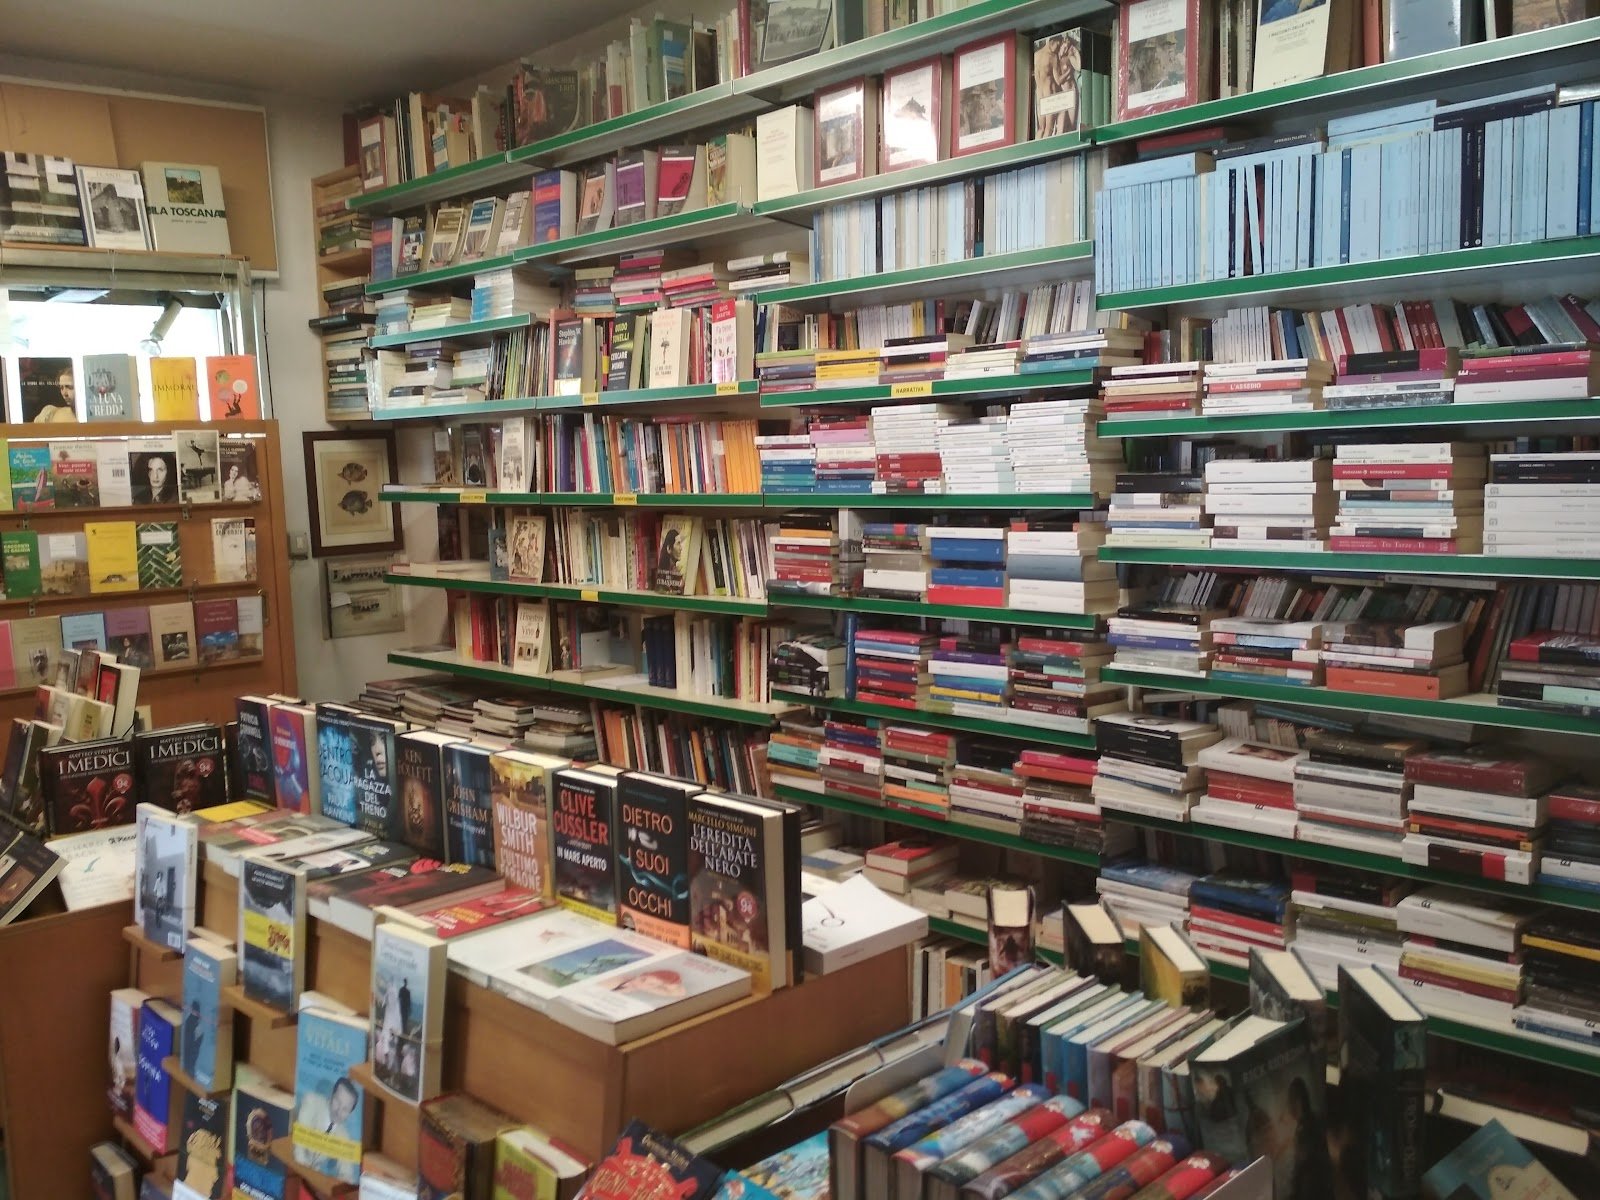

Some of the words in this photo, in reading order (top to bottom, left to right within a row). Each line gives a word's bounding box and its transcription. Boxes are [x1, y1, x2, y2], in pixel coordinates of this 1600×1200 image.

[154, 207, 168, 215] LA
[170, 207, 220, 218] TOSCANA
[895, 386, 924, 394] NARRATIVA
[1230, 382, 1262, 390] L'ASSEDIO
[150, 745, 155, 759] I
[158, 736, 218, 757] MEDICI
[59, 760, 64, 775] I
[67, 750, 130, 774] MEDICI
[364, 768, 376, 780] LA
[354, 776, 392, 796] RAGAZZA
[364, 791, 380, 805] DEL
[453, 784, 476, 802] JOHN
[360, 801, 387, 818] TRENO
[447, 798, 488, 823] GRISHAM
[561, 789, 596, 818] CLIVE
[496, 802, 538, 835] WILBUR
[553, 810, 609, 846] CUSSLER
[622, 804, 673, 835] DIETRO
[688, 811, 725, 829] MARCELLO
[726, 821, 757, 838] SIMONI
[501, 824, 534, 855] SMITH
[556, 846, 563, 858] IN
[564, 848, 581, 864] MARE
[581, 853, 607, 871] APERTO
[636, 848, 669, 876] SUOI
[690, 836, 758, 869] DELL'ABATE
[704, 855, 741, 878] NERO
[628, 887, 673, 918] OCCHI
